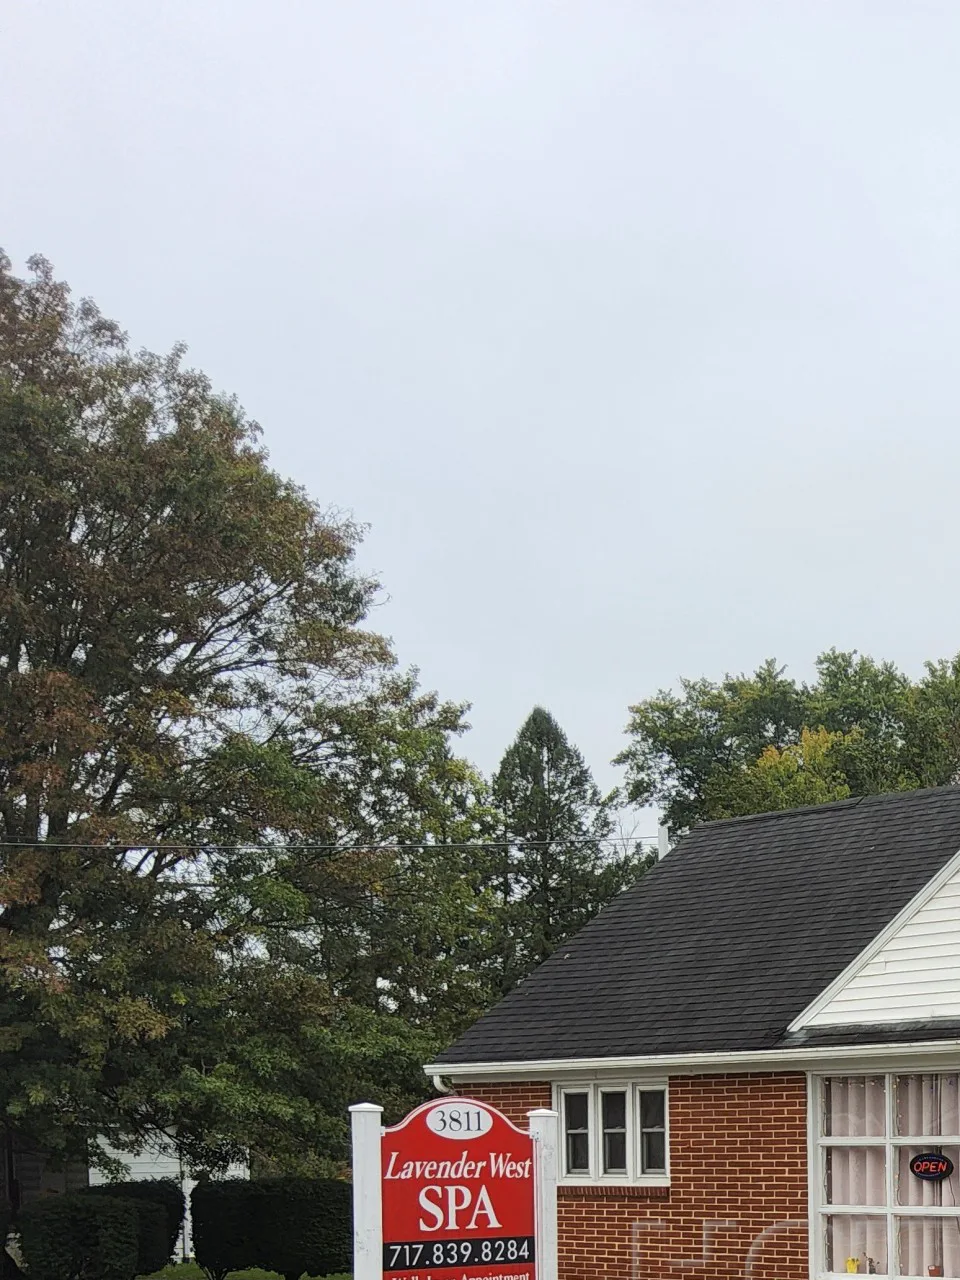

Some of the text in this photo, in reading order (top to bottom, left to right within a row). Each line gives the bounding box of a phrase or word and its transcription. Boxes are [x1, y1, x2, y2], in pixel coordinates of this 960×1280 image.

[435, 1109, 484, 1132] 3811
[384, 1150, 533, 1181] Lavender West
[913, 1161, 948, 1173] OPEN
[419, 1184, 503, 1231] SPA
[389, 1239, 530, 1267] 717.839.8284
